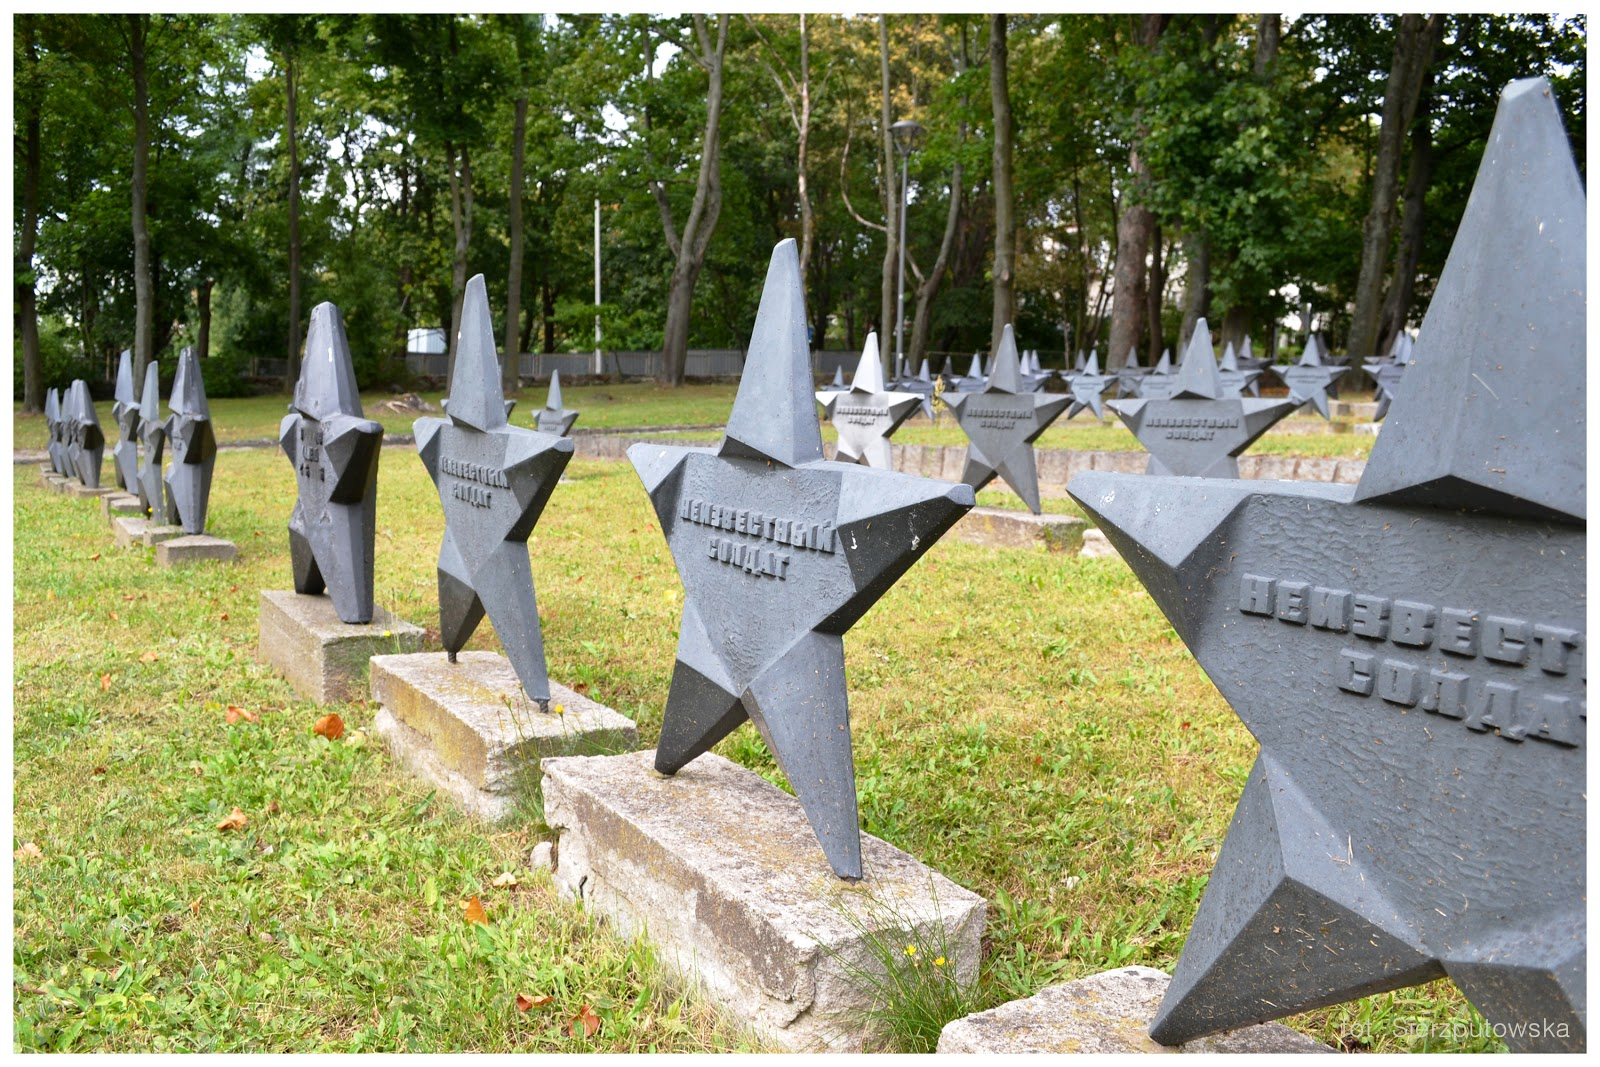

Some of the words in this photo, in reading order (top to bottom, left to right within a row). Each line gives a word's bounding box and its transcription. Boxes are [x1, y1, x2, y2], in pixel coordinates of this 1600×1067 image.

[680, 499, 838, 554] НЕИЗВЕСТНЫЙ
[707, 535, 790, 581] СОЛДАТ
[1337, 648, 1587, 749] СОЛДА
